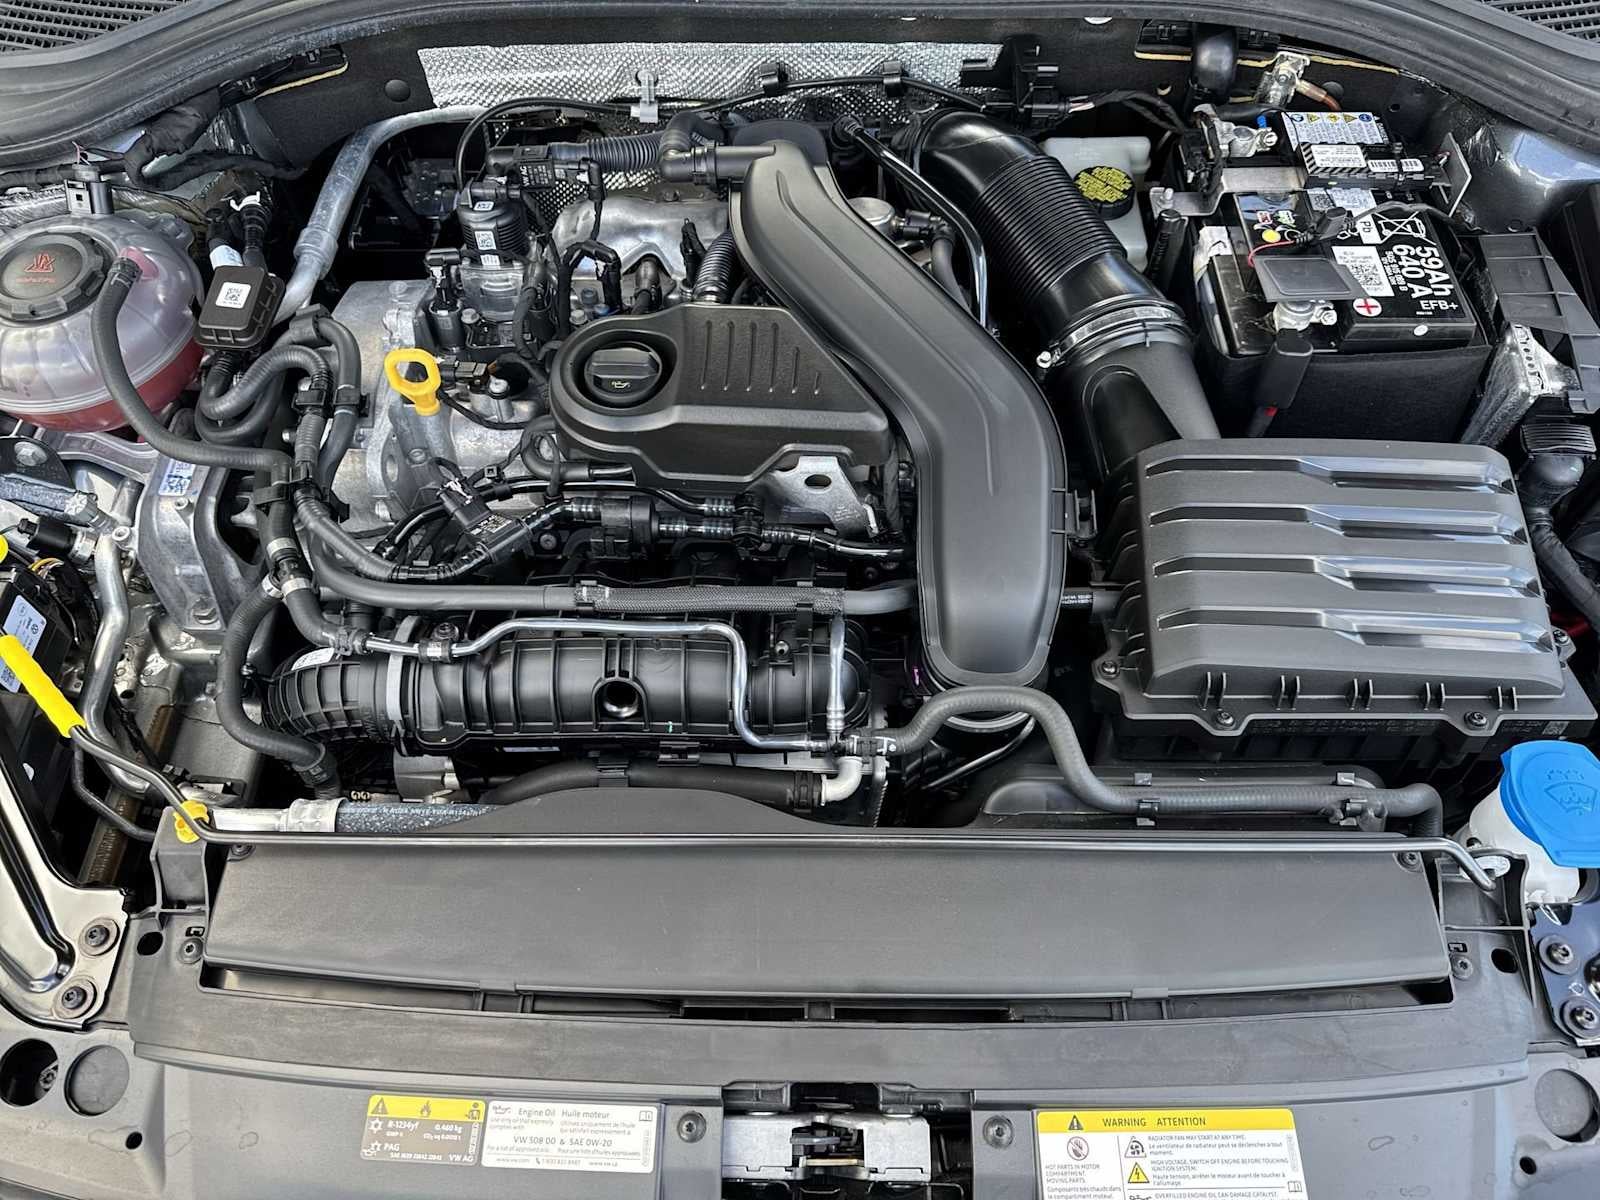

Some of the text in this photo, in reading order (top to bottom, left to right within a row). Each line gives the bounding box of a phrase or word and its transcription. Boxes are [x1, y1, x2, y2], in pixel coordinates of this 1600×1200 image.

[1360, 221, 1373, 233] Pb
[1392, 244, 1425, 279] 640
[1415, 246, 1454, 296] 59Ah
[1406, 283, 1433, 299] A
[1419, 300, 1458, 310] EFB+
[518, 1107, 556, 1118] Engine Oil
[562, 1109, 610, 1119] Huile moteur
[387, 1120, 419, 1132] R-1234yf
[1102, 1117, 1206, 1127] WARNING ATTENTION
[383, 1142, 400, 1152] PAG
[514, 1136, 528, 1144] VW
[545, 1136, 556, 1145] 00
[569, 1138, 583, 1146] SAE
[585, 1138, 613, 1147] 0W-20
